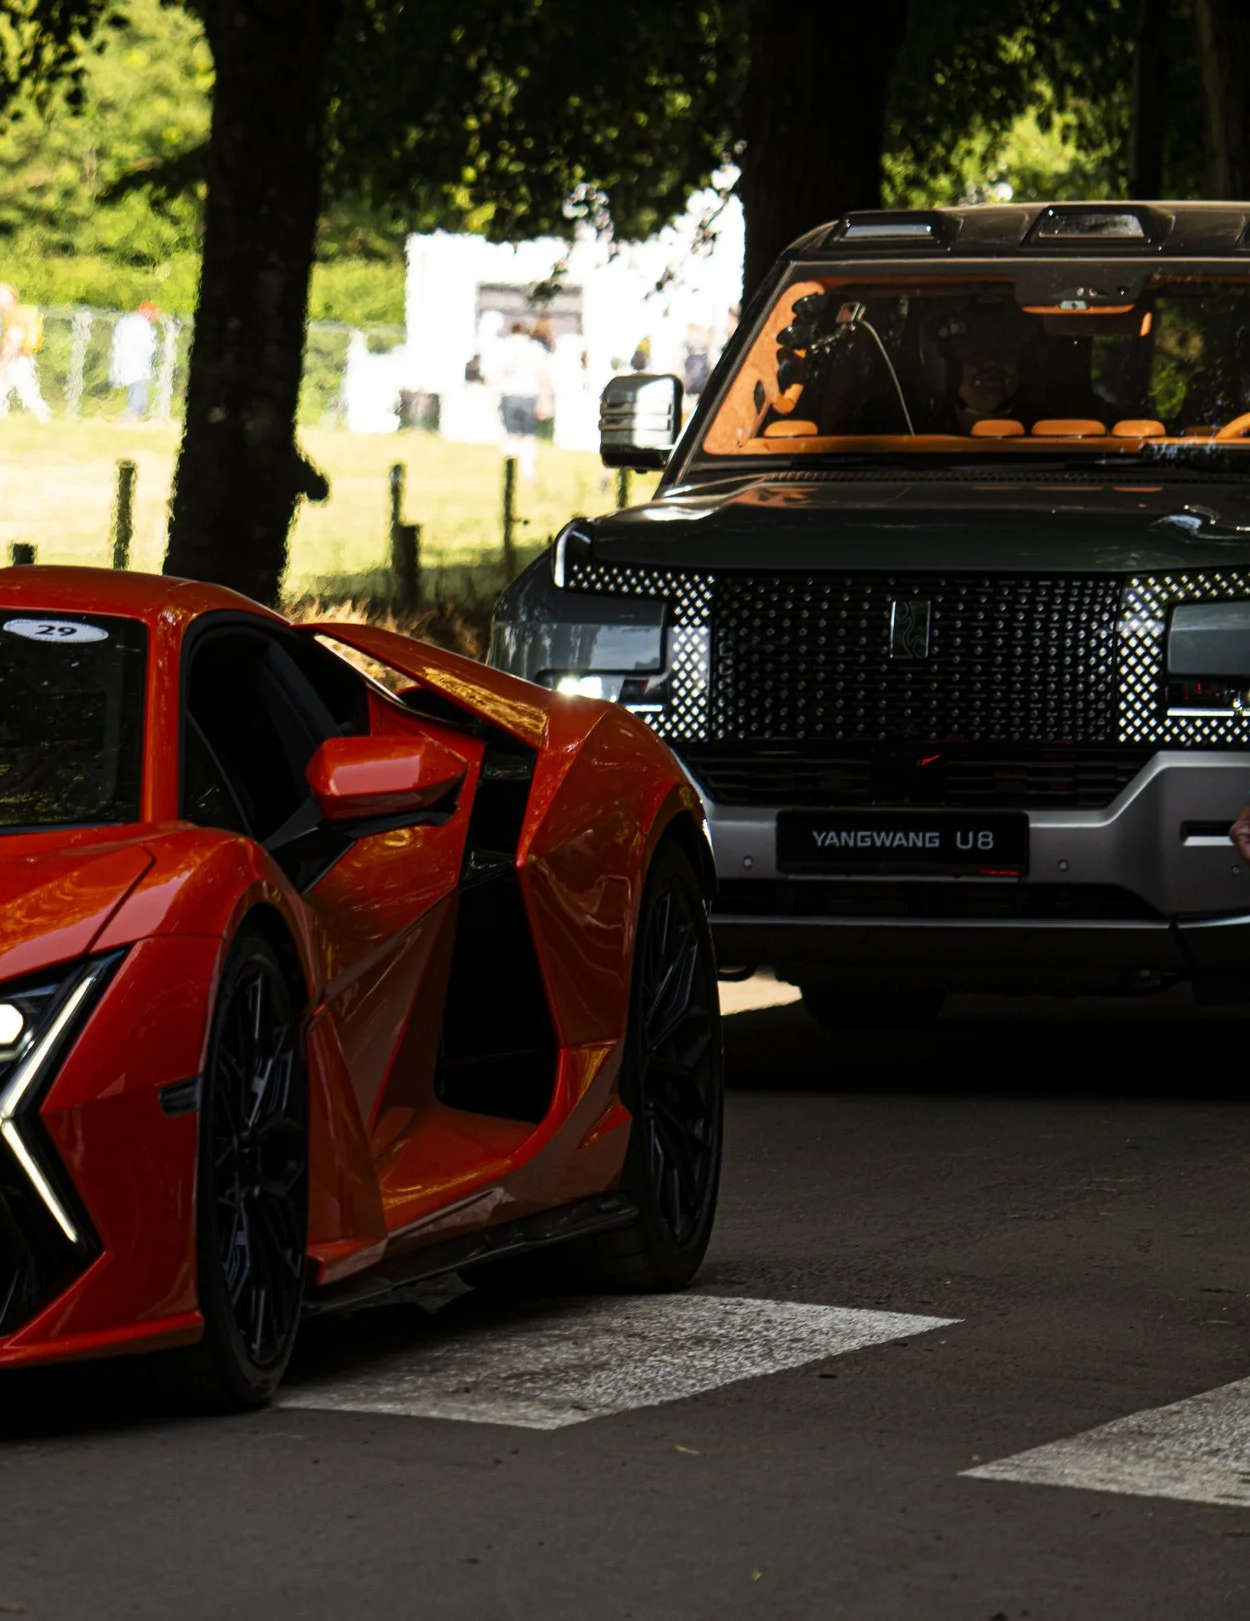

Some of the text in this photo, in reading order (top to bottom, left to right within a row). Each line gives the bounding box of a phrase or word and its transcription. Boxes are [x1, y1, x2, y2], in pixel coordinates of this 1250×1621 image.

[35, 624, 77, 636] 29
[812, 831, 995, 850] YANGWANG U8
